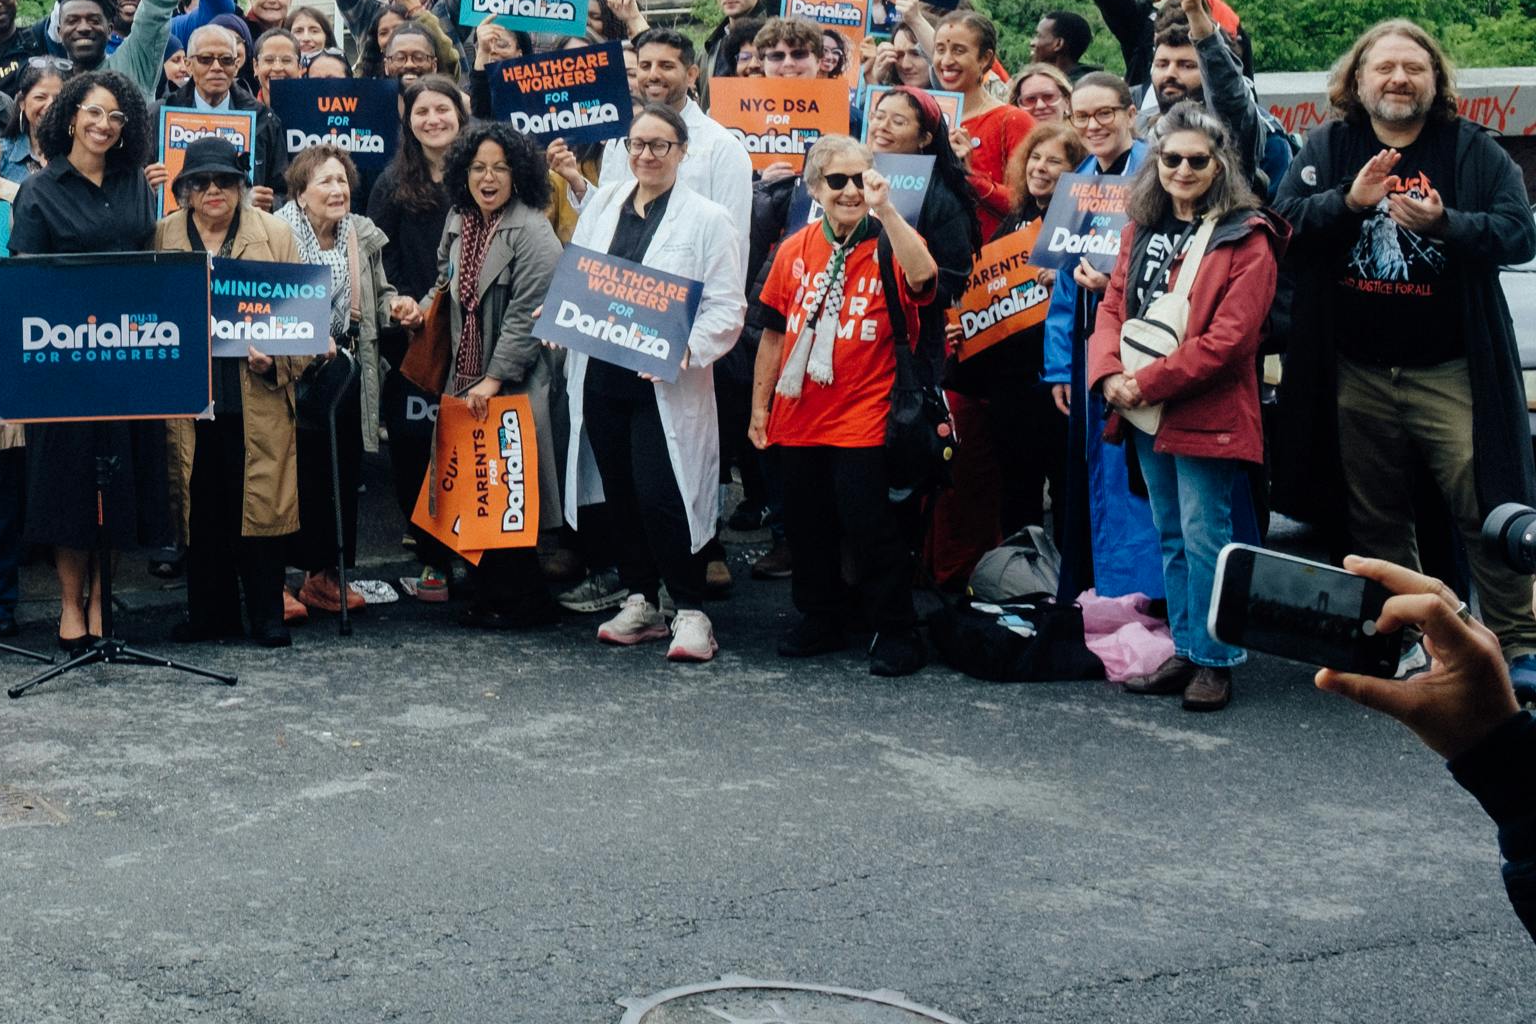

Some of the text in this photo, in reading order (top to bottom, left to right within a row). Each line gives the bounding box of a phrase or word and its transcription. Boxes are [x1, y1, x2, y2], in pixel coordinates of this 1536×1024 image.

[791, 0, 861, 21] Darializa
[502, 51, 609, 82] HEALTHCARE
[517, 68, 597, 94] WORKERS
[317, 96, 358, 113] UAW
[544, 91, 569, 105] FOR
[740, 98, 820, 113] NYC DSA
[327, 116, 350, 126] FOR
[510, 102, 619, 136] Darializa
[766, 114, 790, 125] FOR
[1078, 198, 1127, 212] WORKE
[1090, 216, 1111, 227] FOR
[577, 256, 688, 302] HEALTHCARE
[964, 250, 1029, 293] PARENTS
[211, 279, 326, 299] MINICANOS
[587, 275, 669, 313] WORKERS
[987, 277, 1007, 294] FOR
[1358, 279, 1392, 294] JUSTICE
[1395, 283, 1414, 294] FOR
[1415, 284, 1432, 296] ALL
[238, 302, 271, 314] PARA
[608, 302, 634, 318] FOR
[960, 283, 1049, 339] Darializa
[22, 314, 180, 350] Darializa
[555, 300, 670, 360] Darializa
[786, 312, 878, 342] NME
[23, 348, 180, 364] FOR CONGRESS
[473, 428, 489, 518] PARENTS
[489, 459, 498, 486] FOR
[501, 411, 524, 531] Darializa
